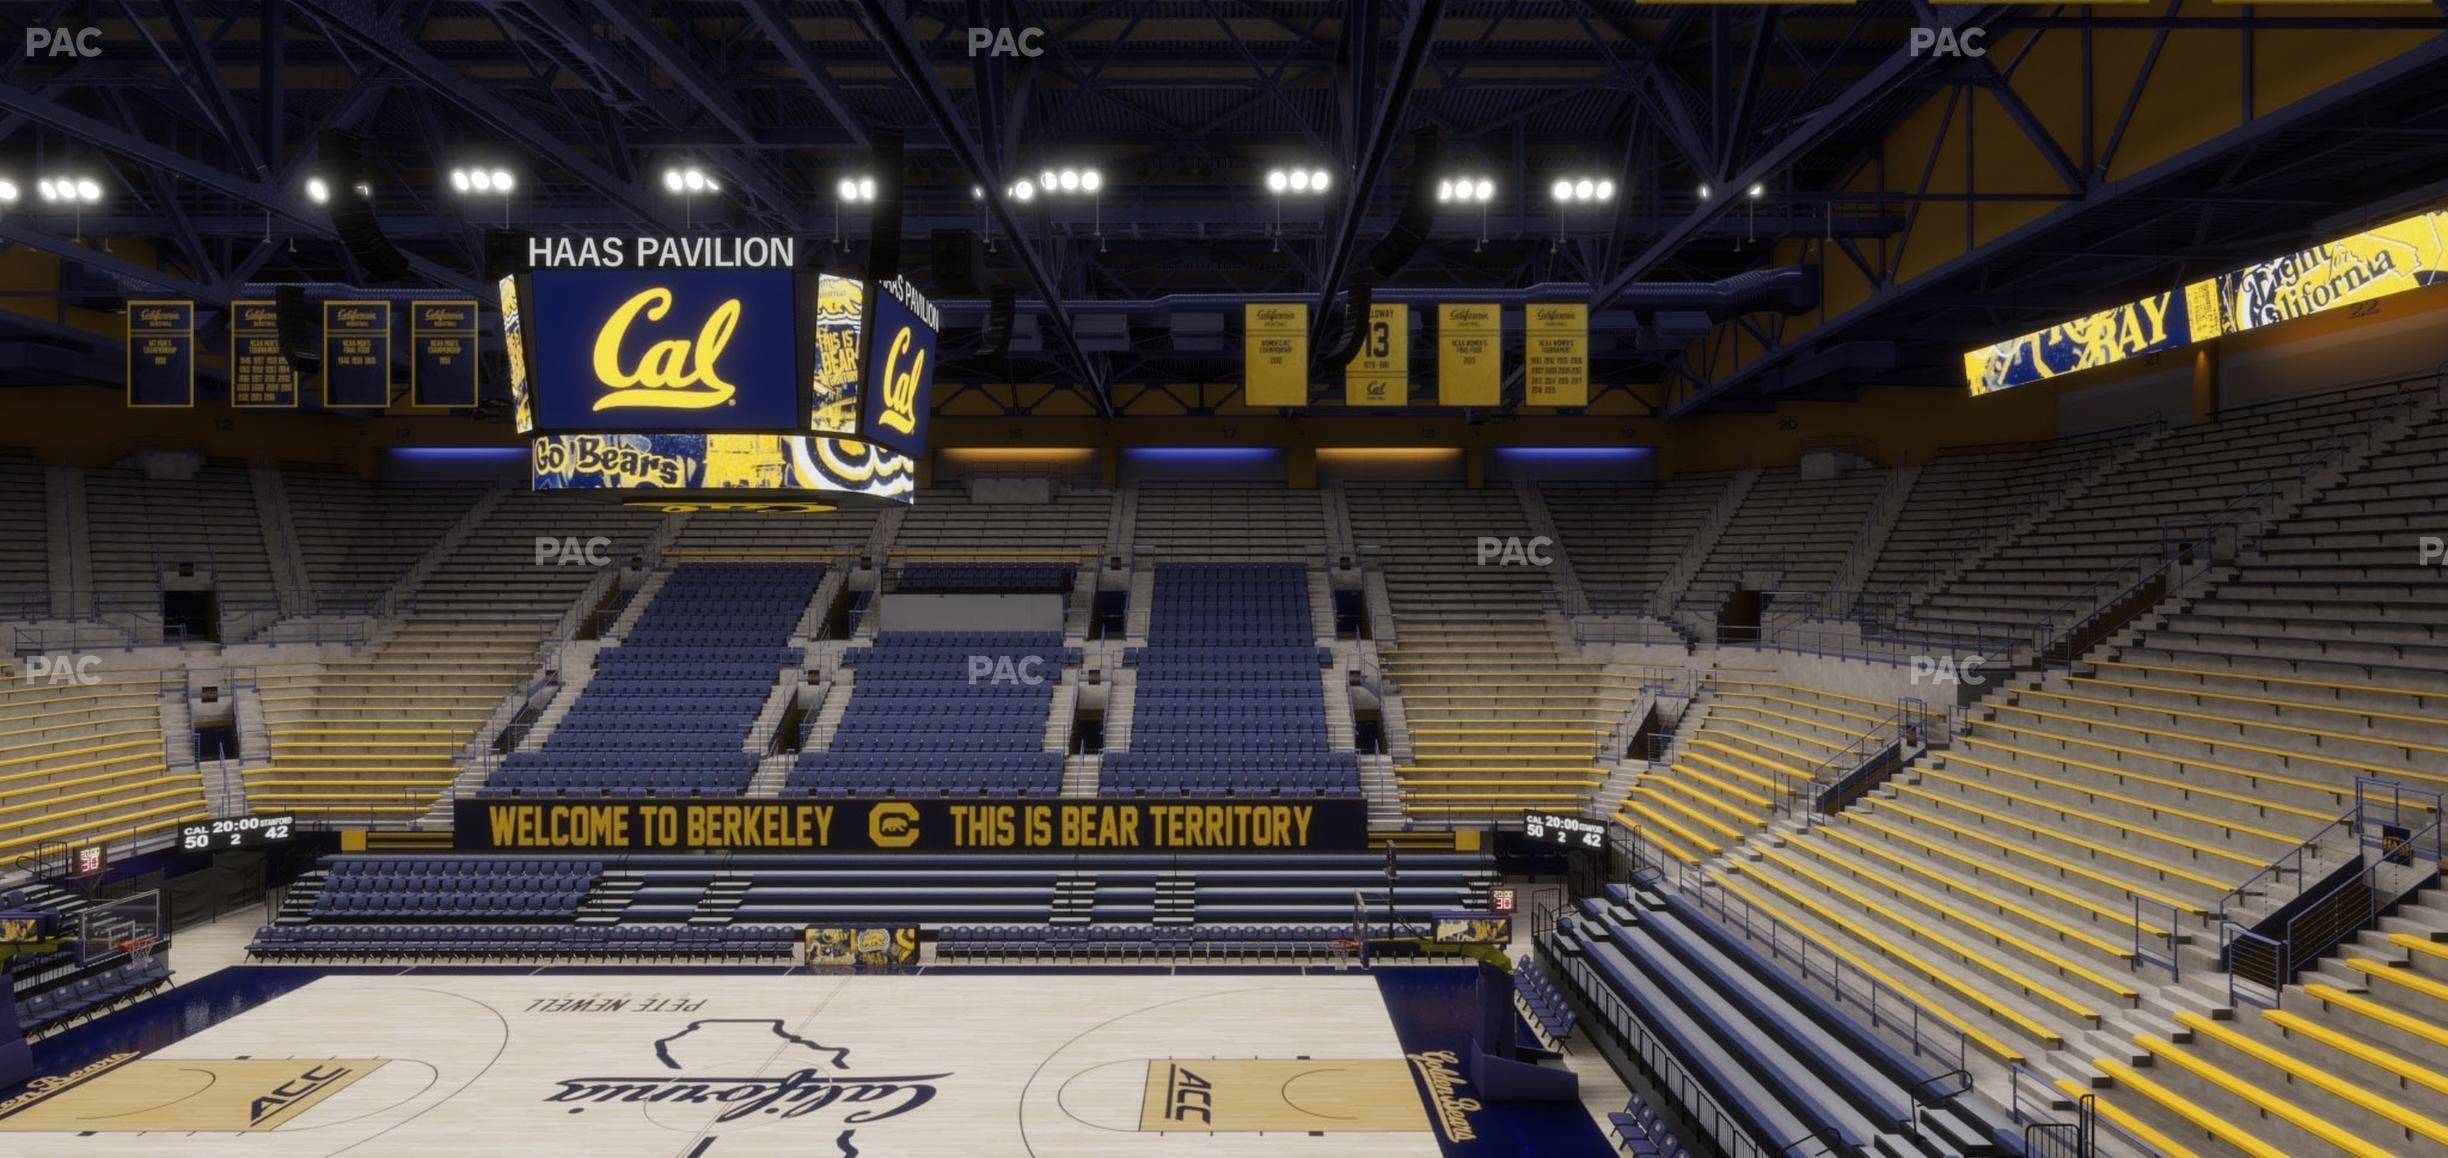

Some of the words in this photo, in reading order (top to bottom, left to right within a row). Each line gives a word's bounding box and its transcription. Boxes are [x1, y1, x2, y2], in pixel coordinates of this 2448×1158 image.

[529, 236, 624, 268] HAAS
[637, 236, 794, 268] PAVILION
[905, 281, 939, 333] PAVILION
[592, 286, 741, 411] Cal
[820, 333, 841, 351] THIS
[842, 330, 854, 348] IS
[1364, 322, 1390, 358] 13
[821, 348, 857, 376] BEAR
[879, 326, 925, 434] Cal
[1366, 380, 1387, 396] Cal
[538, 436, 566, 471] Go
[577, 437, 681, 486] Bears
[184, 826, 209, 836] CAL
[213, 818, 259, 834] 20:00
[185, 835, 209, 849] 50
[230, 833, 242, 845] 2
[265, 825, 289, 839] 42
[489, 806, 630, 847] WELCOME
[639, 806, 679, 847] TO
[687, 806, 835, 847] BERKELEY
[949, 806, 1016, 847] THIS
[1024, 806, 1052, 847] IS
[1061, 806, 1140, 847] BEAR
[1149, 806, 1314, 847] TERRITORY
[1527, 815, 1545, 825] CAL
[1546, 815, 1579, 831] 20:00
[1527, 823, 1544, 838] 50
[1558, 831, 1567, 843] 2
[1583, 833, 1602, 847] 42
[1496, 897, 1512, 910] 30
[524, 998, 631, 1012] NEWELL
[632, 998, 709, 1012] PETE
[250, 1065, 347, 1122] ACC
[1421, 1051, 1467, 1104] Golden
[543, 1069, 956, 1123] California
[1175, 1066, 1212, 1126] ACC
[1442, 1098, 1482, 1141] Bears
